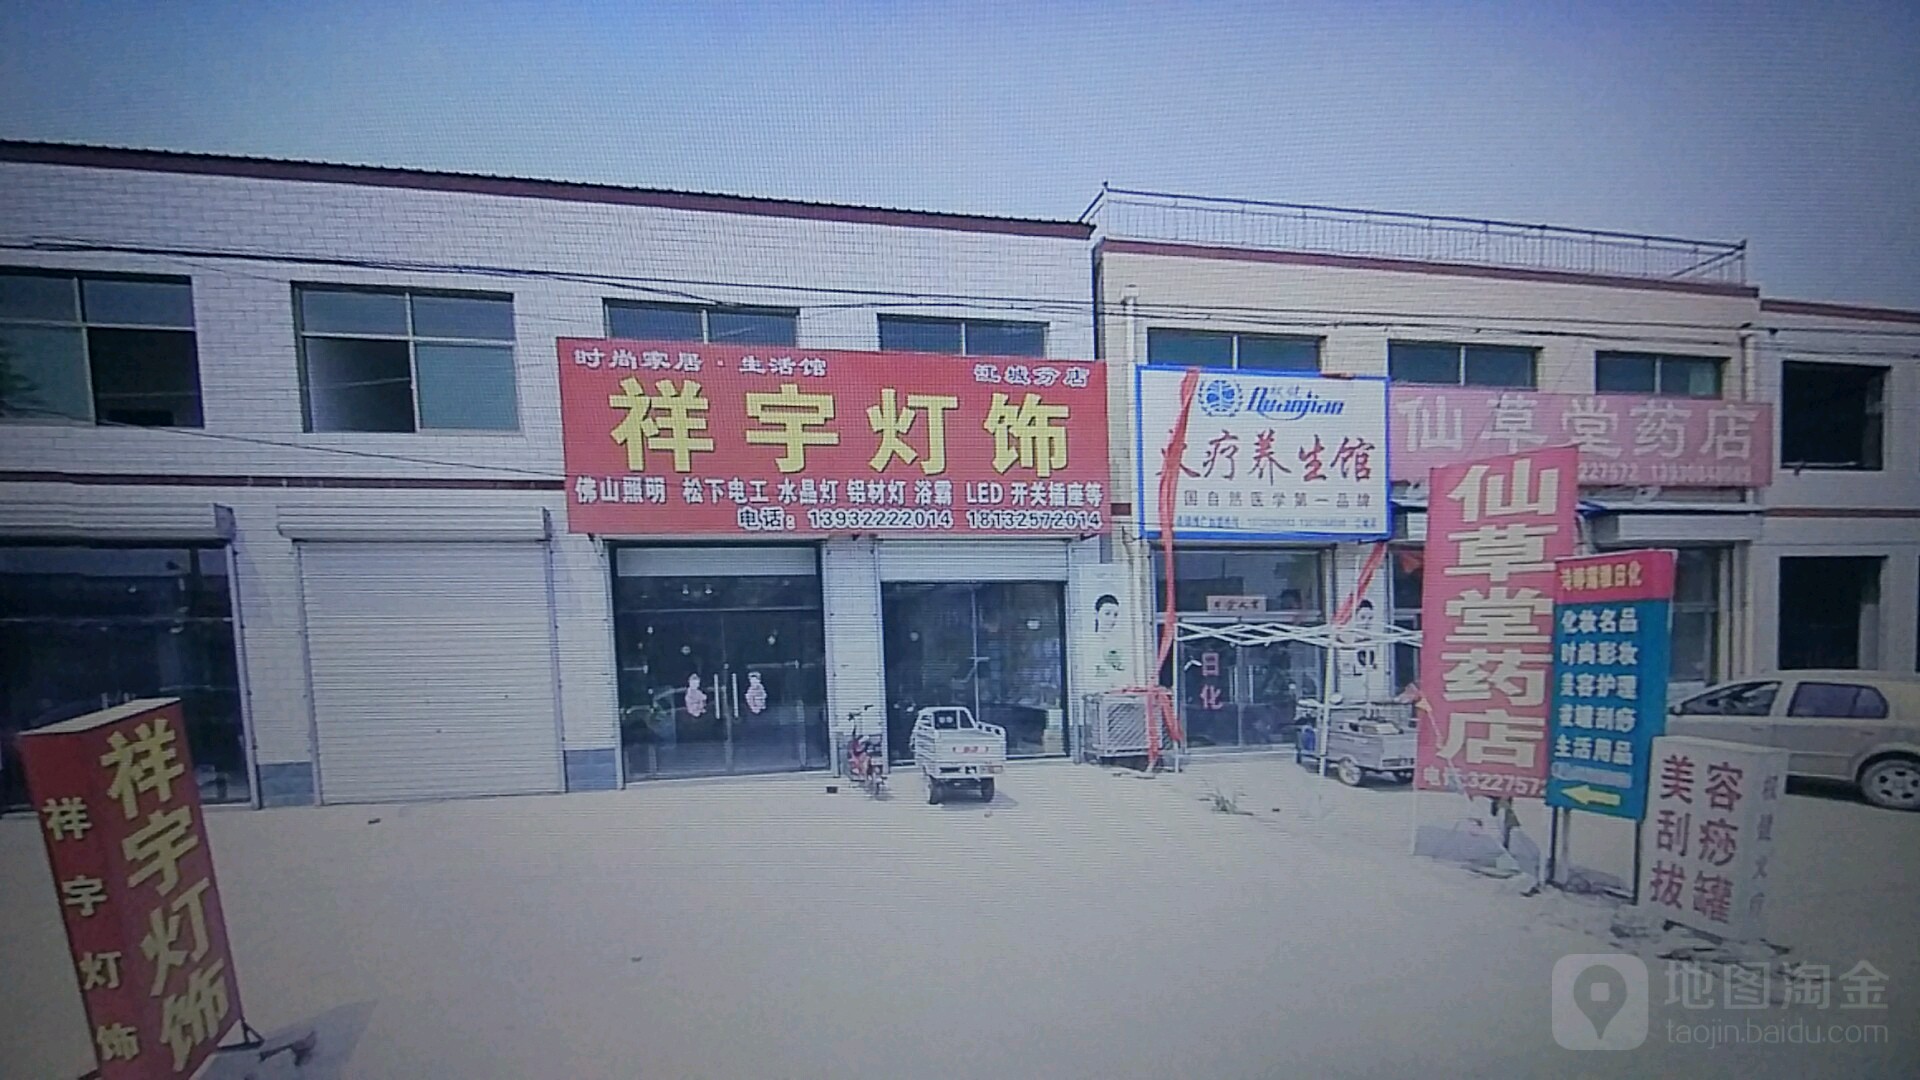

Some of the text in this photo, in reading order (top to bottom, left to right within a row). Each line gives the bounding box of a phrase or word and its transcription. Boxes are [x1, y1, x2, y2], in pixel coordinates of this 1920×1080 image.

[609, 377, 1070, 478] 祥宇灯饰
[1399, 394, 1759, 460] 仙草堂药店
[574, 476, 667, 504] 佛山照明
[682, 477, 769, 505] 松下电工
[777, 477, 838, 505] 水晶灯
[914, 479, 953, 506] 浴霸
[966, 481, 1004, 504] LED
[1010, 481, 1103, 508] 开关插座等
[808, 508, 954, 530] 13932222014
[966, 510, 1104, 531] 18132572014
[1182, 490, 1372, 509] 国自然医学第一品牌
[1437, 457, 1560, 769] 仙草堂药店
[1554, 733, 1633, 766] 生活用品
[1659, 755, 1743, 813] 美容
[1656, 809, 1739, 867] 刮痧
[100, 718, 229, 1073] 祥宇灯饰
[1650, 860, 1734, 925] 拔罐
[42, 797, 140, 1061] 祥宇灯饰
